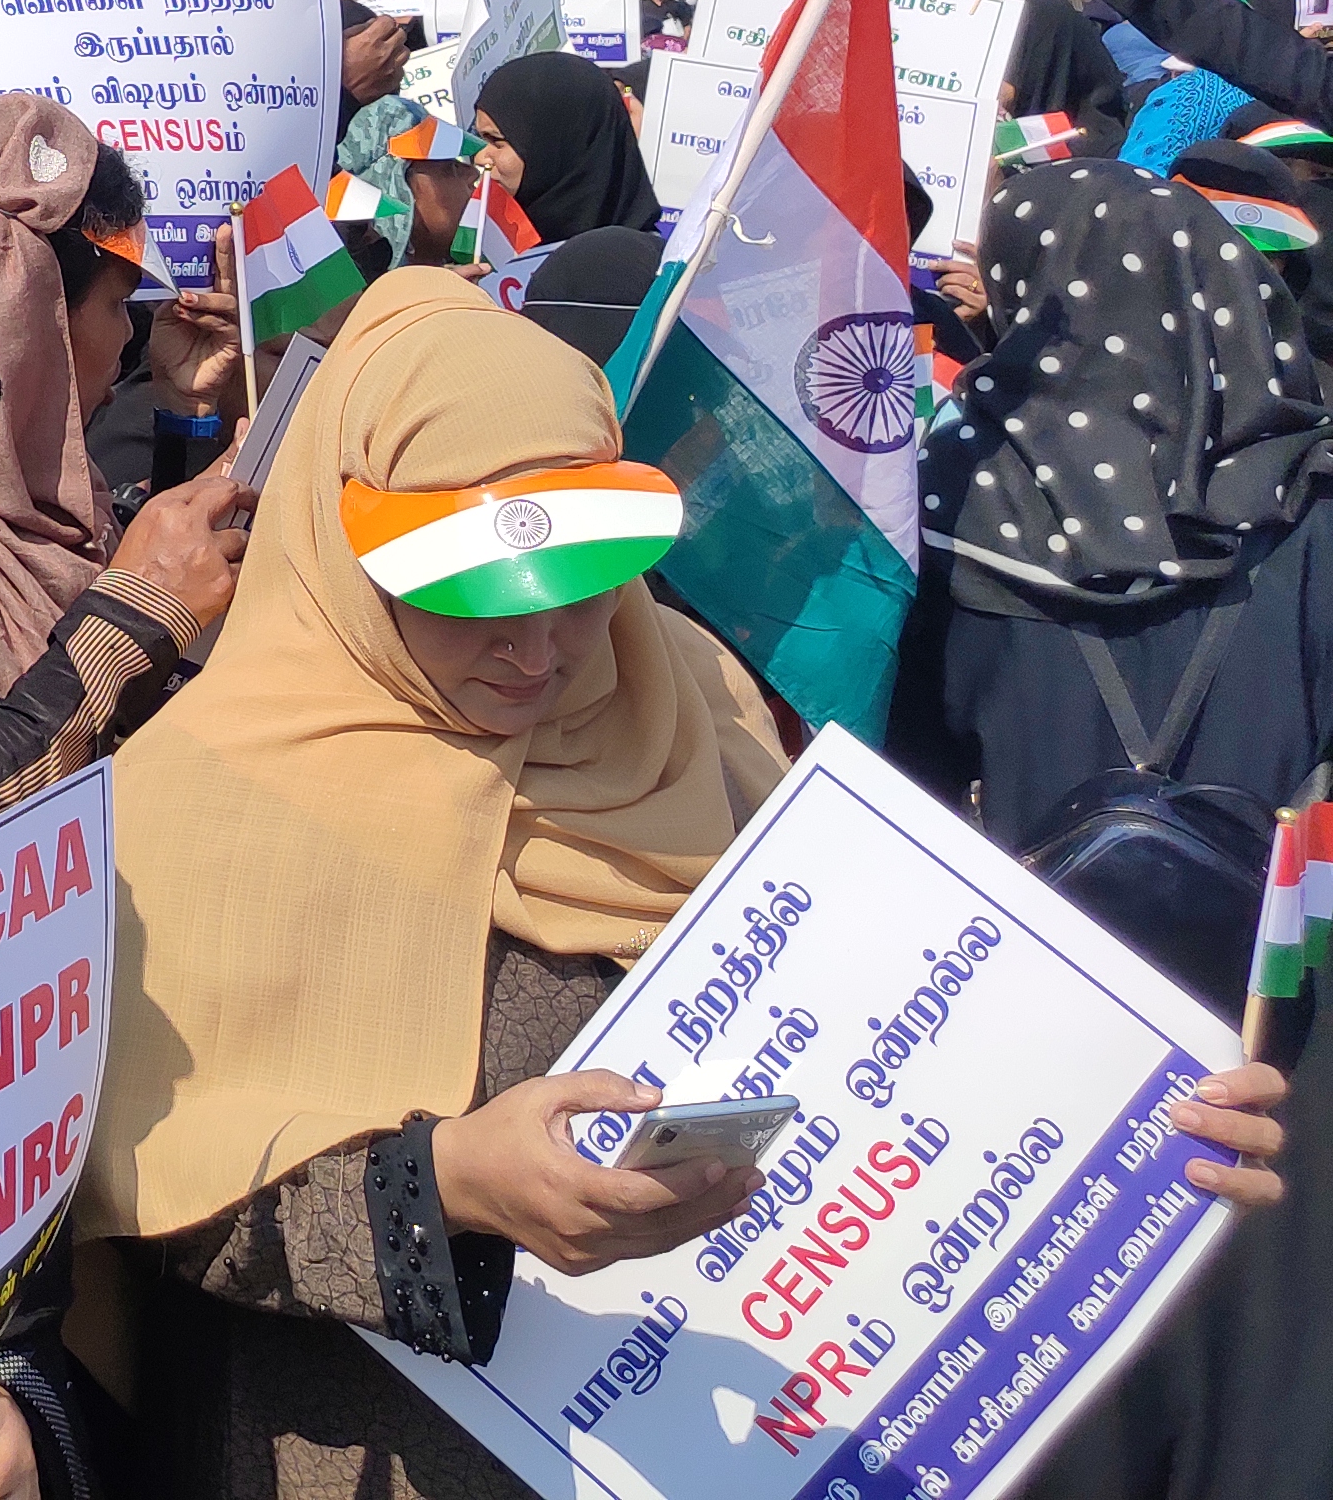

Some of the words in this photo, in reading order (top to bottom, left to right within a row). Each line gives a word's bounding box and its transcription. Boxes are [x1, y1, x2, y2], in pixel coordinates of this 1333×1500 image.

[73, 26, 235, 63] இருப்பதால்
[91, 72, 207, 111] விஷமும்
[221, 72, 320, 111] ஒன்றல்ல
[95, 117, 247, 154] CENSUSம்
[666, 879, 813, 1068] நிறத்தில்
[559, 1289, 689, 1436] பாலும்
[845, 914, 1004, 1111] ஒன்றல்ல
[740, 1111, 952, 1342] CENSUSம்
[753, 1313, 898, 1458] NPRம்
[901, 1116, 1065, 1315] ஒன்றல்ல
[857, 1335, 988, 1474] இஸ்லாமிய
[982, 1172, 1121, 1332] இயக்கங்கள்
[1114, 1070, 1198, 1174] மற்றும்
[950, 1331, 1070, 1465] கட்சிகளின்
[1066, 1180, 1199, 1333] கூட்டமைப்பு
